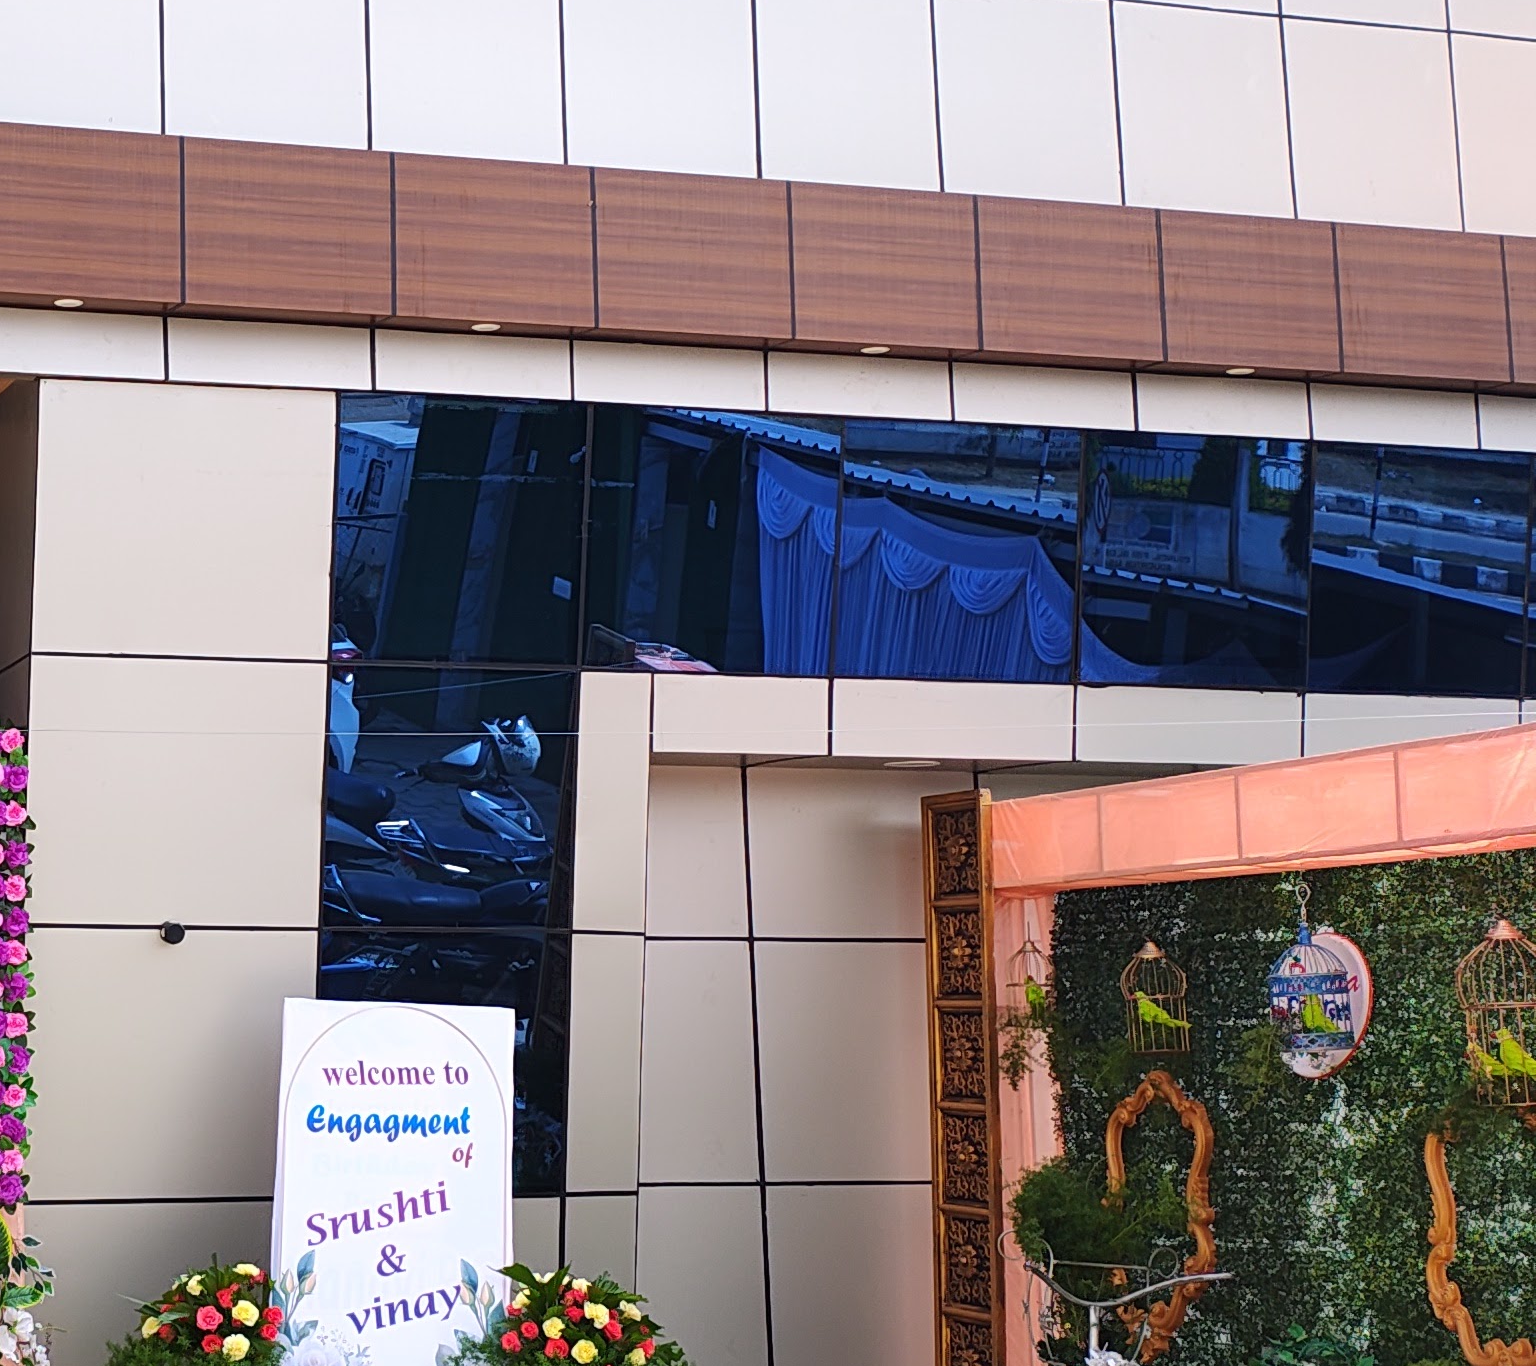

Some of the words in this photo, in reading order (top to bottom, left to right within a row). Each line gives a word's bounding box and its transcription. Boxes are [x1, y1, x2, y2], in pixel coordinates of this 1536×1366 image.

[322, 1060, 436, 1086] welcome
[443, 1060, 469, 1086] to
[306, 1104, 471, 1143] Engagment
[451, 1143, 474, 1168] of
[305, 1180, 451, 1246] Srushti
[375, 1244, 407, 1277] &
[345, 1283, 462, 1336] vinay
